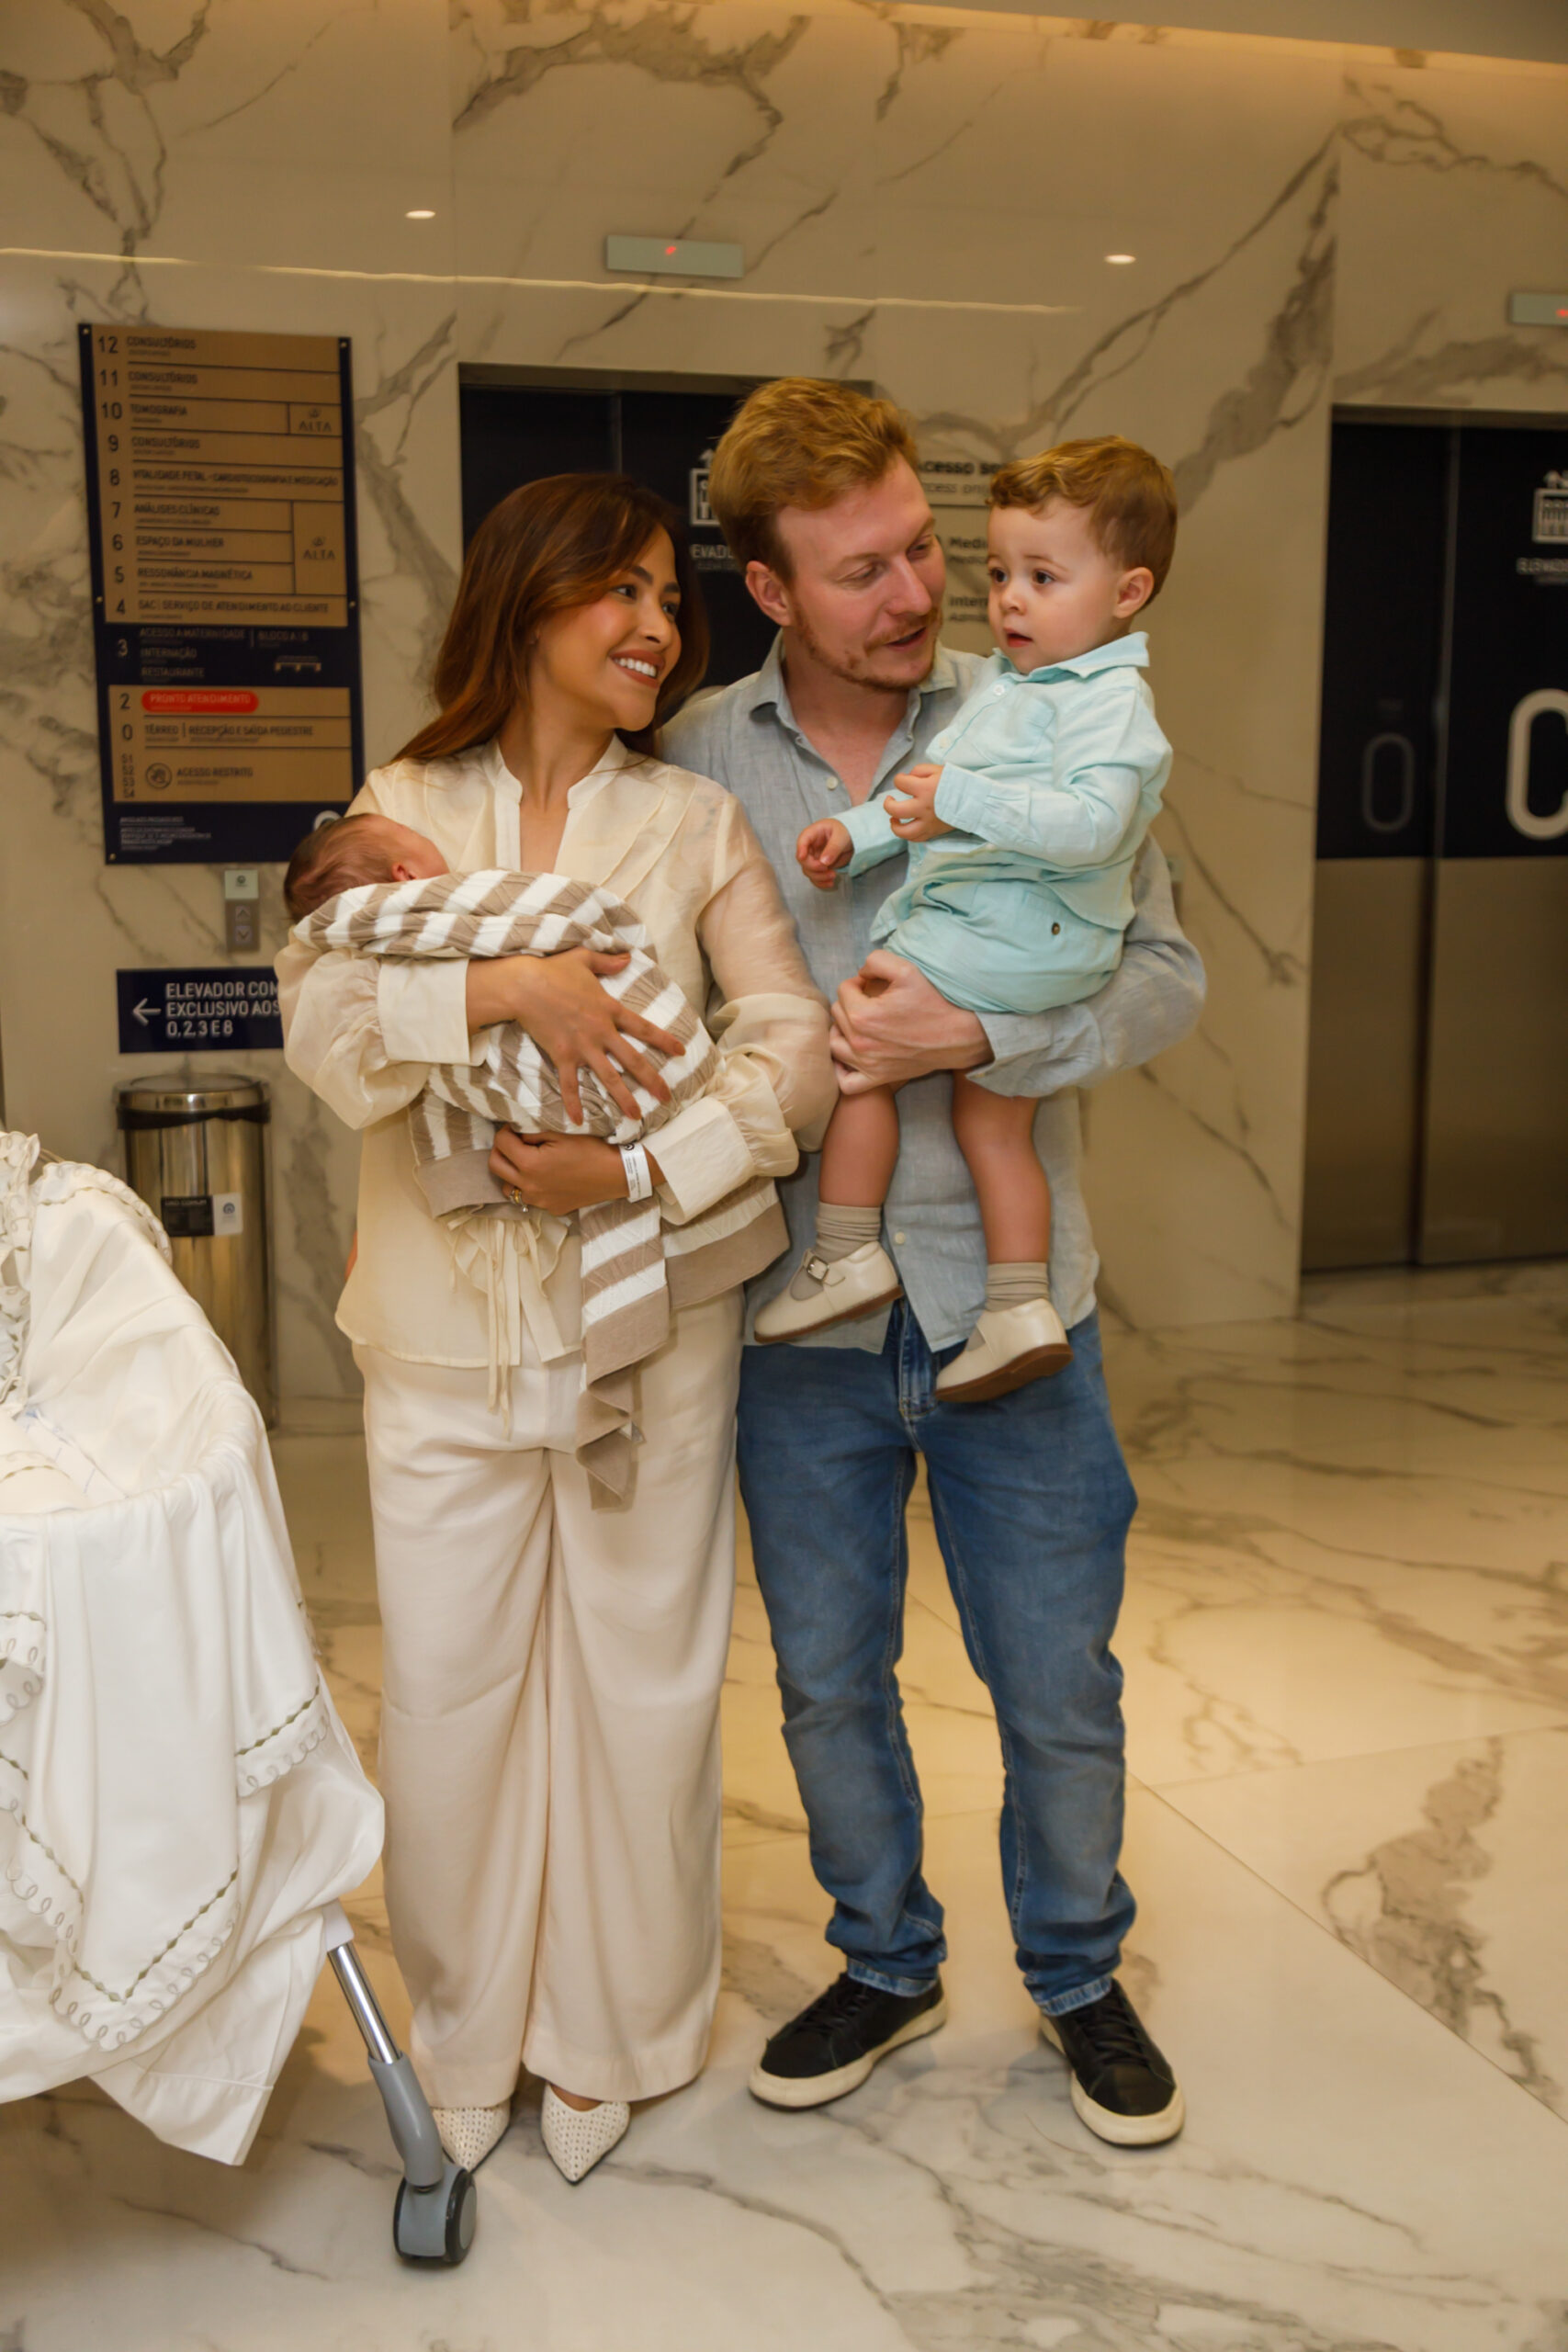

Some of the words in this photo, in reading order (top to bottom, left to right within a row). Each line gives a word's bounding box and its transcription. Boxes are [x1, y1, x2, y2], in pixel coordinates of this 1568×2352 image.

[98, 336, 118, 354] 12
[127, 336, 197, 349] CONSULTÓRIOS
[100, 369, 118, 387] 11
[128, 371, 197, 384] CONSULTÓRIOS
[102, 401, 122, 419] 10
[130, 404, 187, 416] TOMOGRAFIA
[299, 421, 332, 433] ALTA
[107, 435, 118, 452] 9
[131, 435, 200, 449] CONSULTÓRIOS
[110, 469, 120, 486] 8
[112, 502, 121, 519] 7
[112, 534, 123, 551] 6
[136, 536, 170, 548] ESPAÇO
[950, 537, 988, 548] Medi
[303, 549, 335, 560] ALTA
[115, 566, 125, 583] 5
[116, 599, 126, 616] 4
[163, 600, 199, 613] SERVIÇO
[201, 601, 214, 611] DE
[216, 601, 278, 612] ATENDIMENTO
[117, 639, 129, 658] 3
[119, 693, 131, 709] 2
[150, 694, 186, 704] PRONTO
[186, 694, 252, 705] ATENDIMENTO
[122, 724, 133, 741] 0
[188, 723, 235, 737] RECEPÇÃO
[269, 726, 314, 737] PEDESTRE
[166, 981, 245, 999] ELEVADOR
[166, 1000, 249, 1017] EXCLUSIVO
[252, 1000, 281, 1015] AOS
[211, 1020, 221, 1035] E
[223, 1019, 234, 1035] 8
